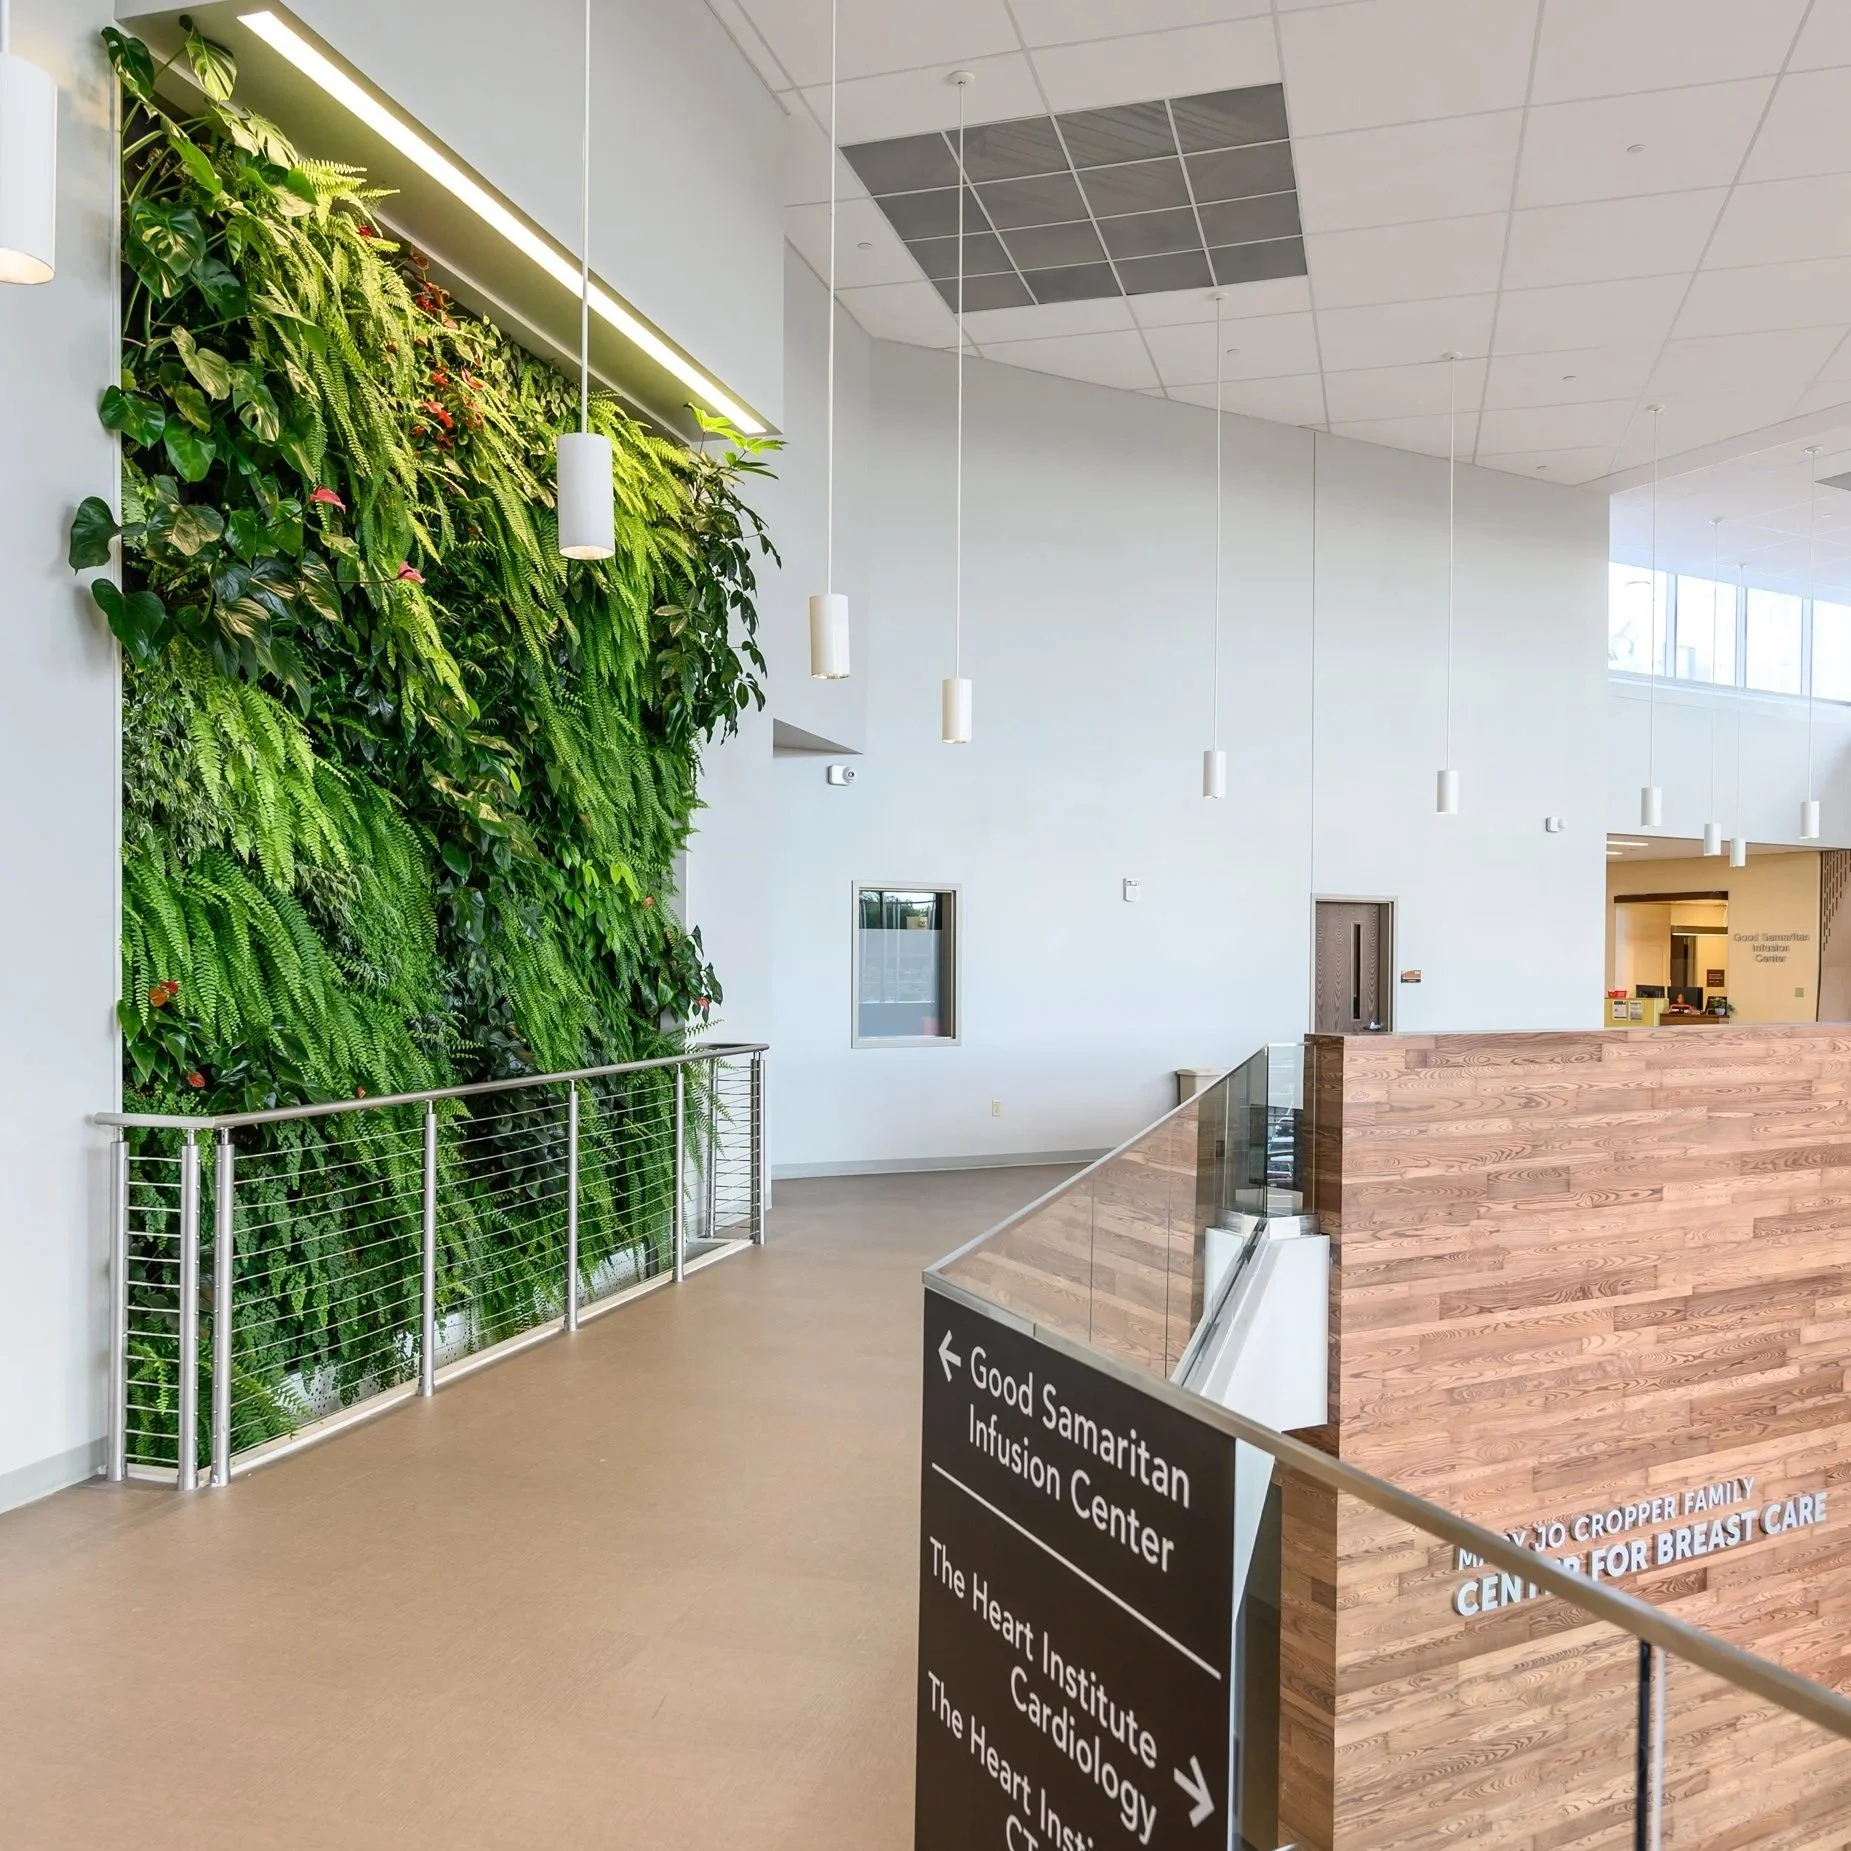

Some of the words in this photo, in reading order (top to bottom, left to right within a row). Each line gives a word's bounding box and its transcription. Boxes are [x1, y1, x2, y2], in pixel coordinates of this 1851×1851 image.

[1733, 932, 1759, 942] Good
[1755, 953, 1787, 963] Center
[969, 1403, 1061, 1501] Infusion
[1070, 1468, 1175, 1573] Center
[970, 1345, 1033, 1418] Good
[1042, 1383, 1190, 1509] Samaritan
[1456, 1530, 1526, 1571] MY
[1531, 1522, 1566, 1553] JO
[1570, 1496, 1677, 1542] CROPPER
[1681, 1476, 1756, 1515] FAMILY
[1588, 1539, 1648, 1582] FOR
[1653, 1510, 1758, 1566] BREAST
[1759, 1490, 1829, 1536] CARE
[929, 1535, 966, 1599] The
[972, 1572, 1034, 1662] Heart
[1043, 1631, 1158, 1769] Institute
[928, 1670, 964, 1739] The
[970, 1715, 1032, 1816] Heart
[1010, 1665, 1157, 1846] Cardiology
